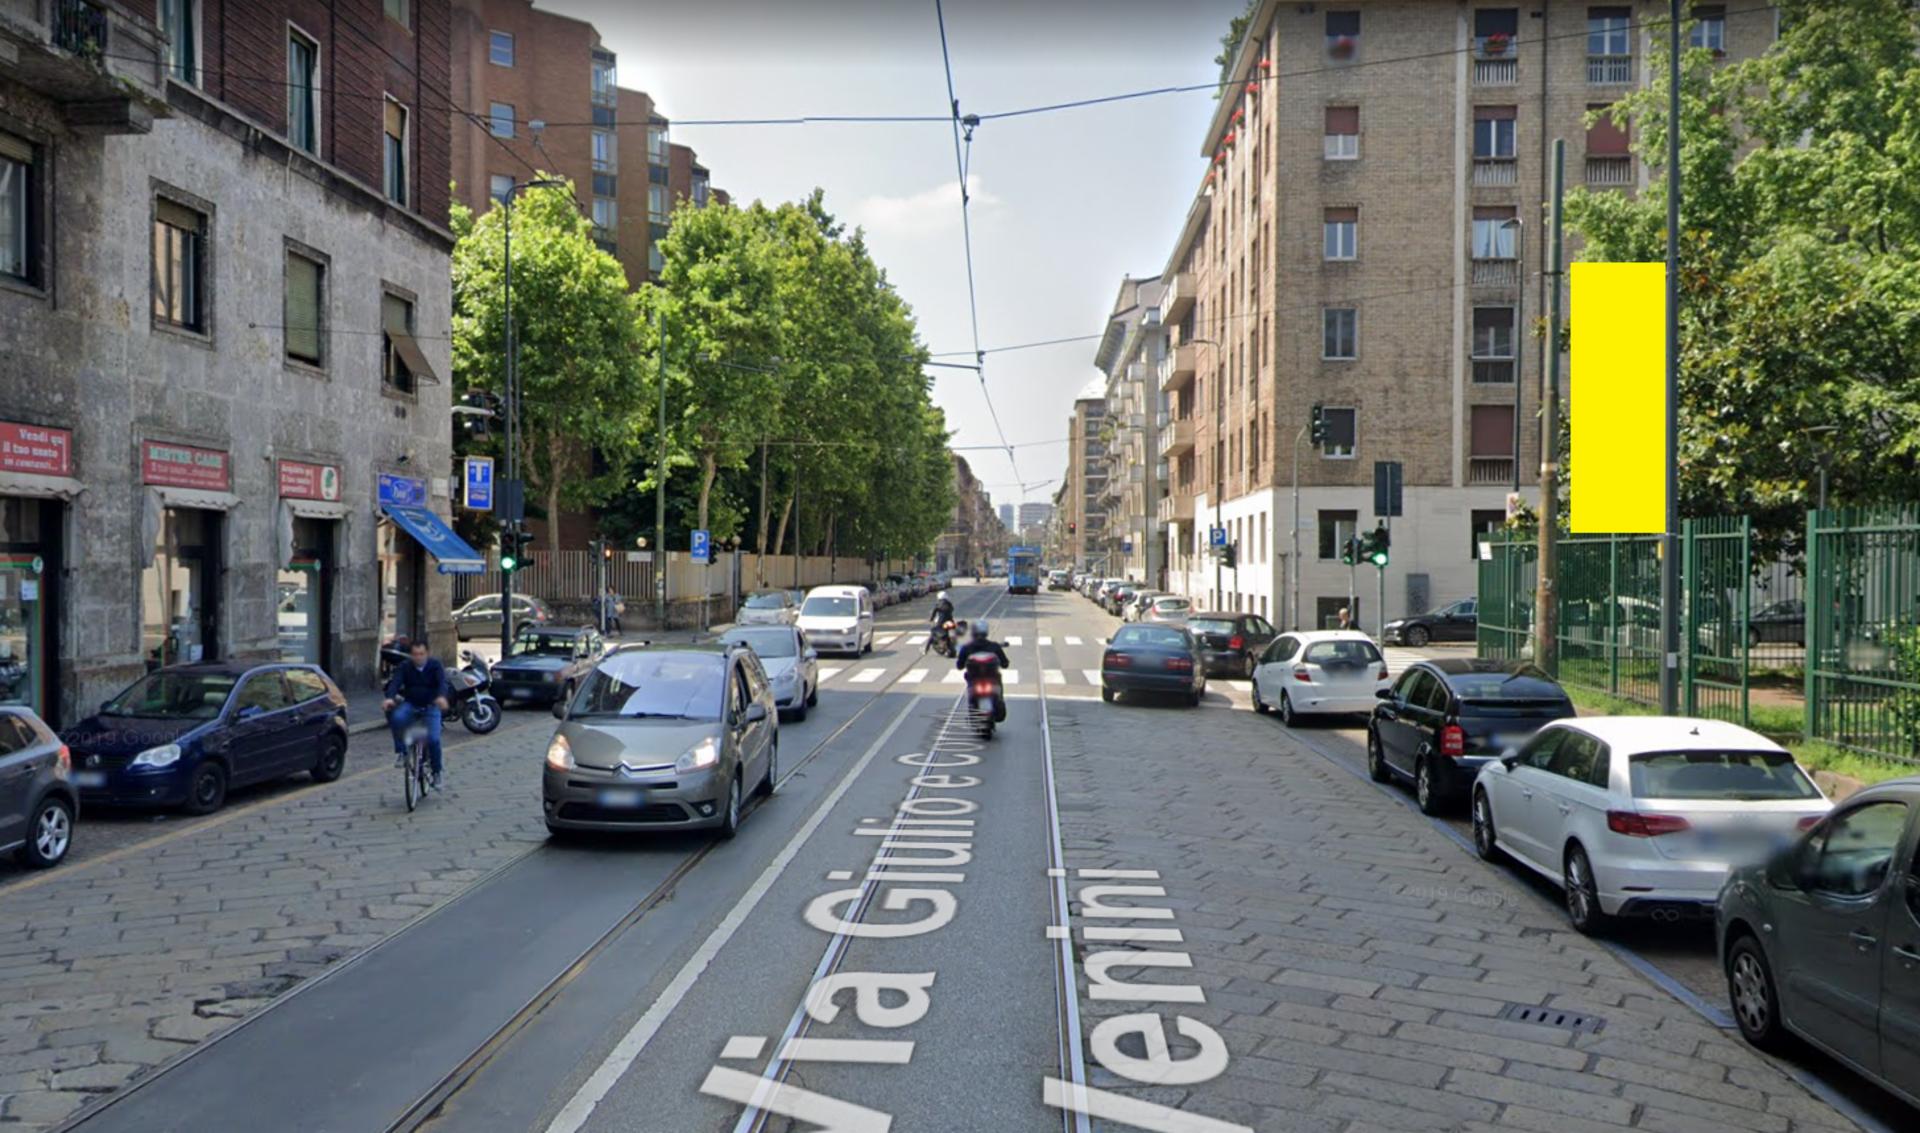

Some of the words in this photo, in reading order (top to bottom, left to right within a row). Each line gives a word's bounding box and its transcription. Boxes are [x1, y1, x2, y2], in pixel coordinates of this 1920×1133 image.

[19, 428, 48, 442] Vendi
[13, 443, 30, 455] tuo
[32, 447, 58, 459] usato
[694, 533, 706, 547] P
[1213, 531, 1224, 544] P
